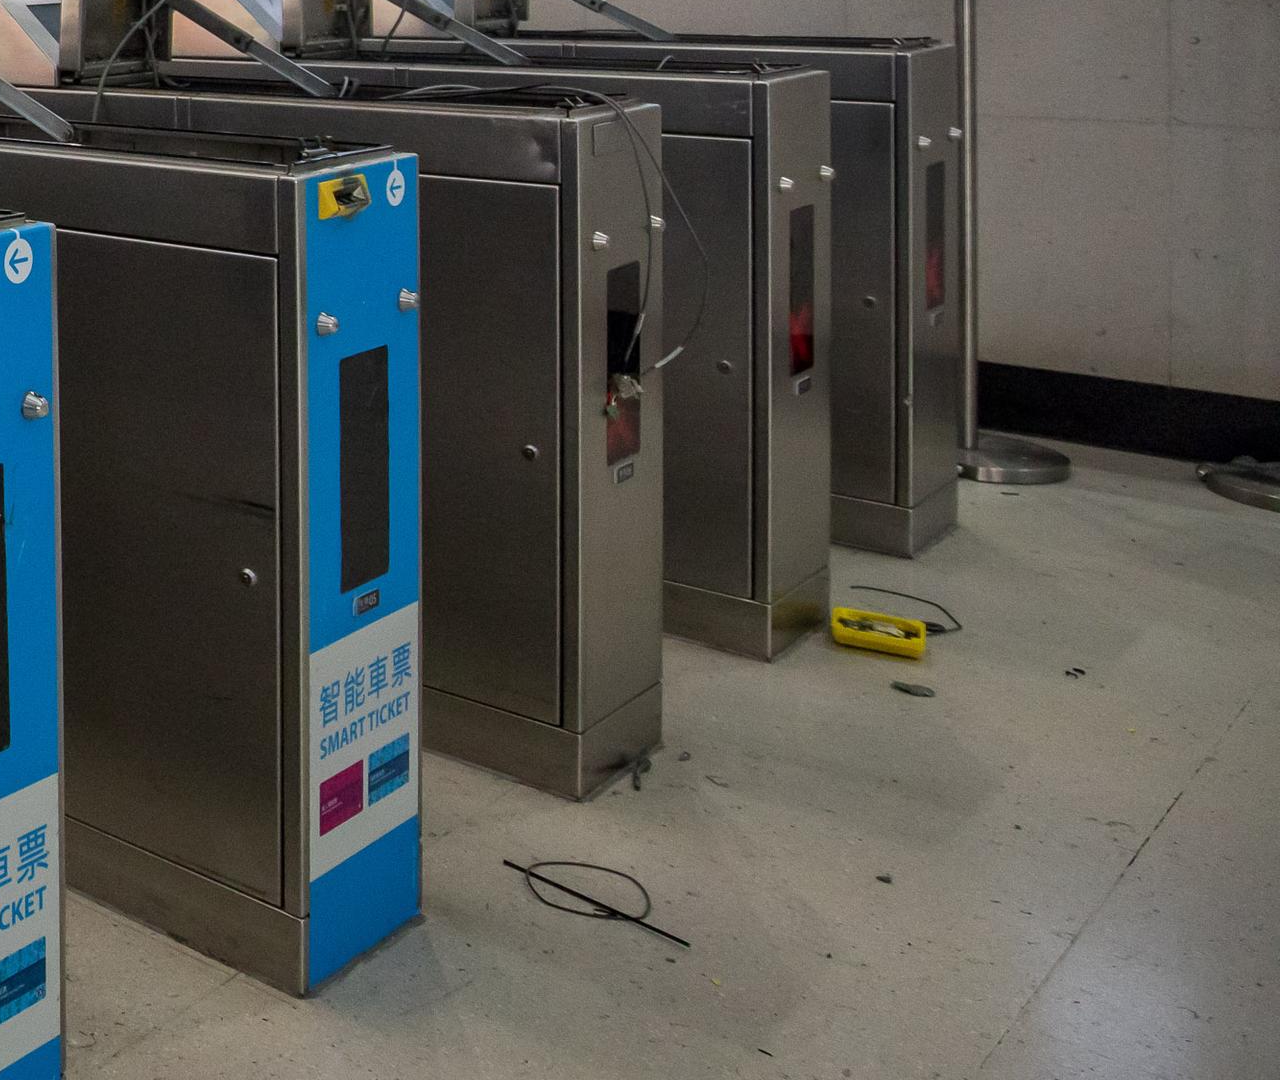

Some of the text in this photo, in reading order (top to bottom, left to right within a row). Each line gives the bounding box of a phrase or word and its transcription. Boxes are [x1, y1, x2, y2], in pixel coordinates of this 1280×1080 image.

[319, 641, 412, 728] 智能車票
[319, 691, 411, 761] SMART TICKET
